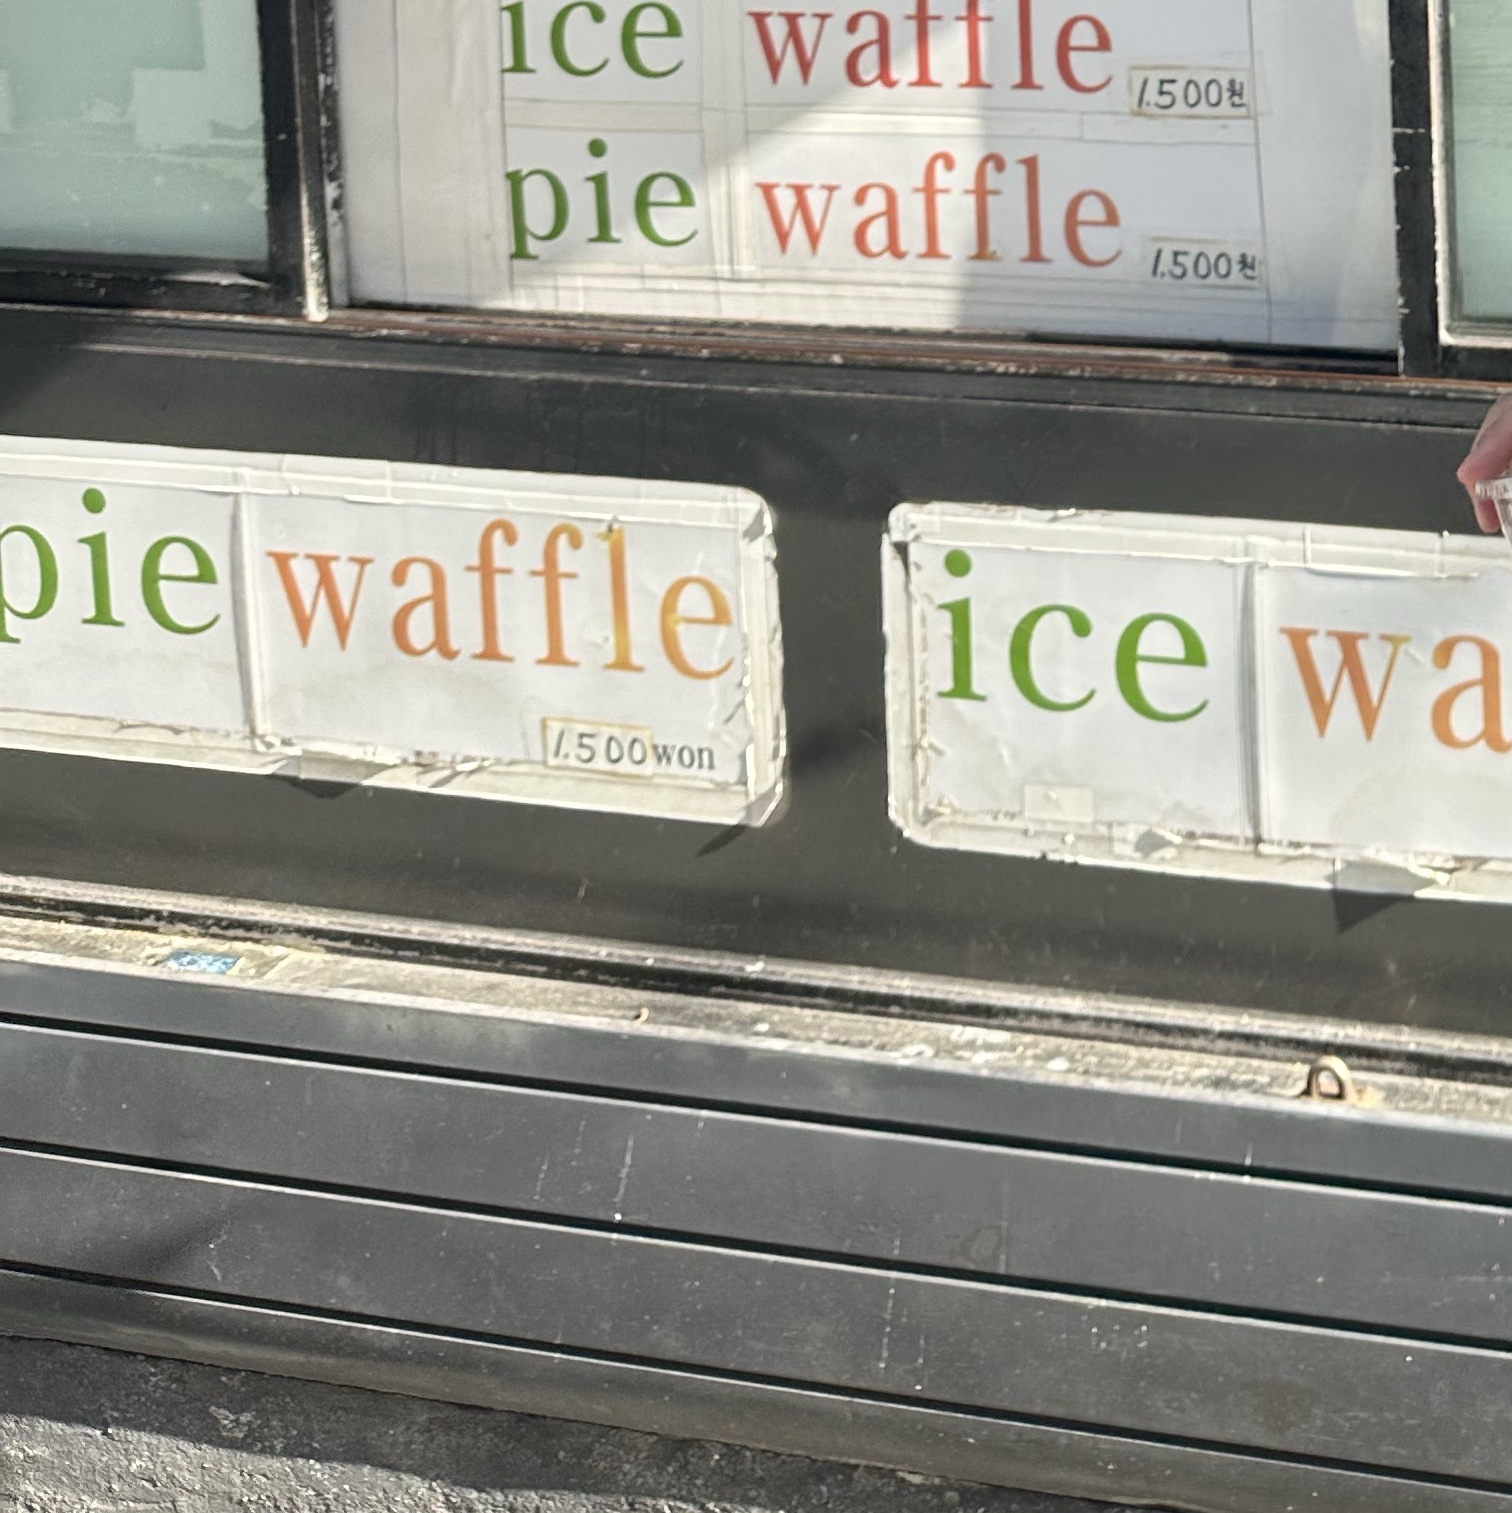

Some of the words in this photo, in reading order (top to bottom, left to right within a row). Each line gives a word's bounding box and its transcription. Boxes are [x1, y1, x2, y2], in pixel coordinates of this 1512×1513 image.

[505, 138, 698, 260] pie
[755, 151, 1123, 267] waffle
[0, 487, 221, 644] pie
[266, 519, 735, 680] waffle
[935, 549, 1209, 723] ice
